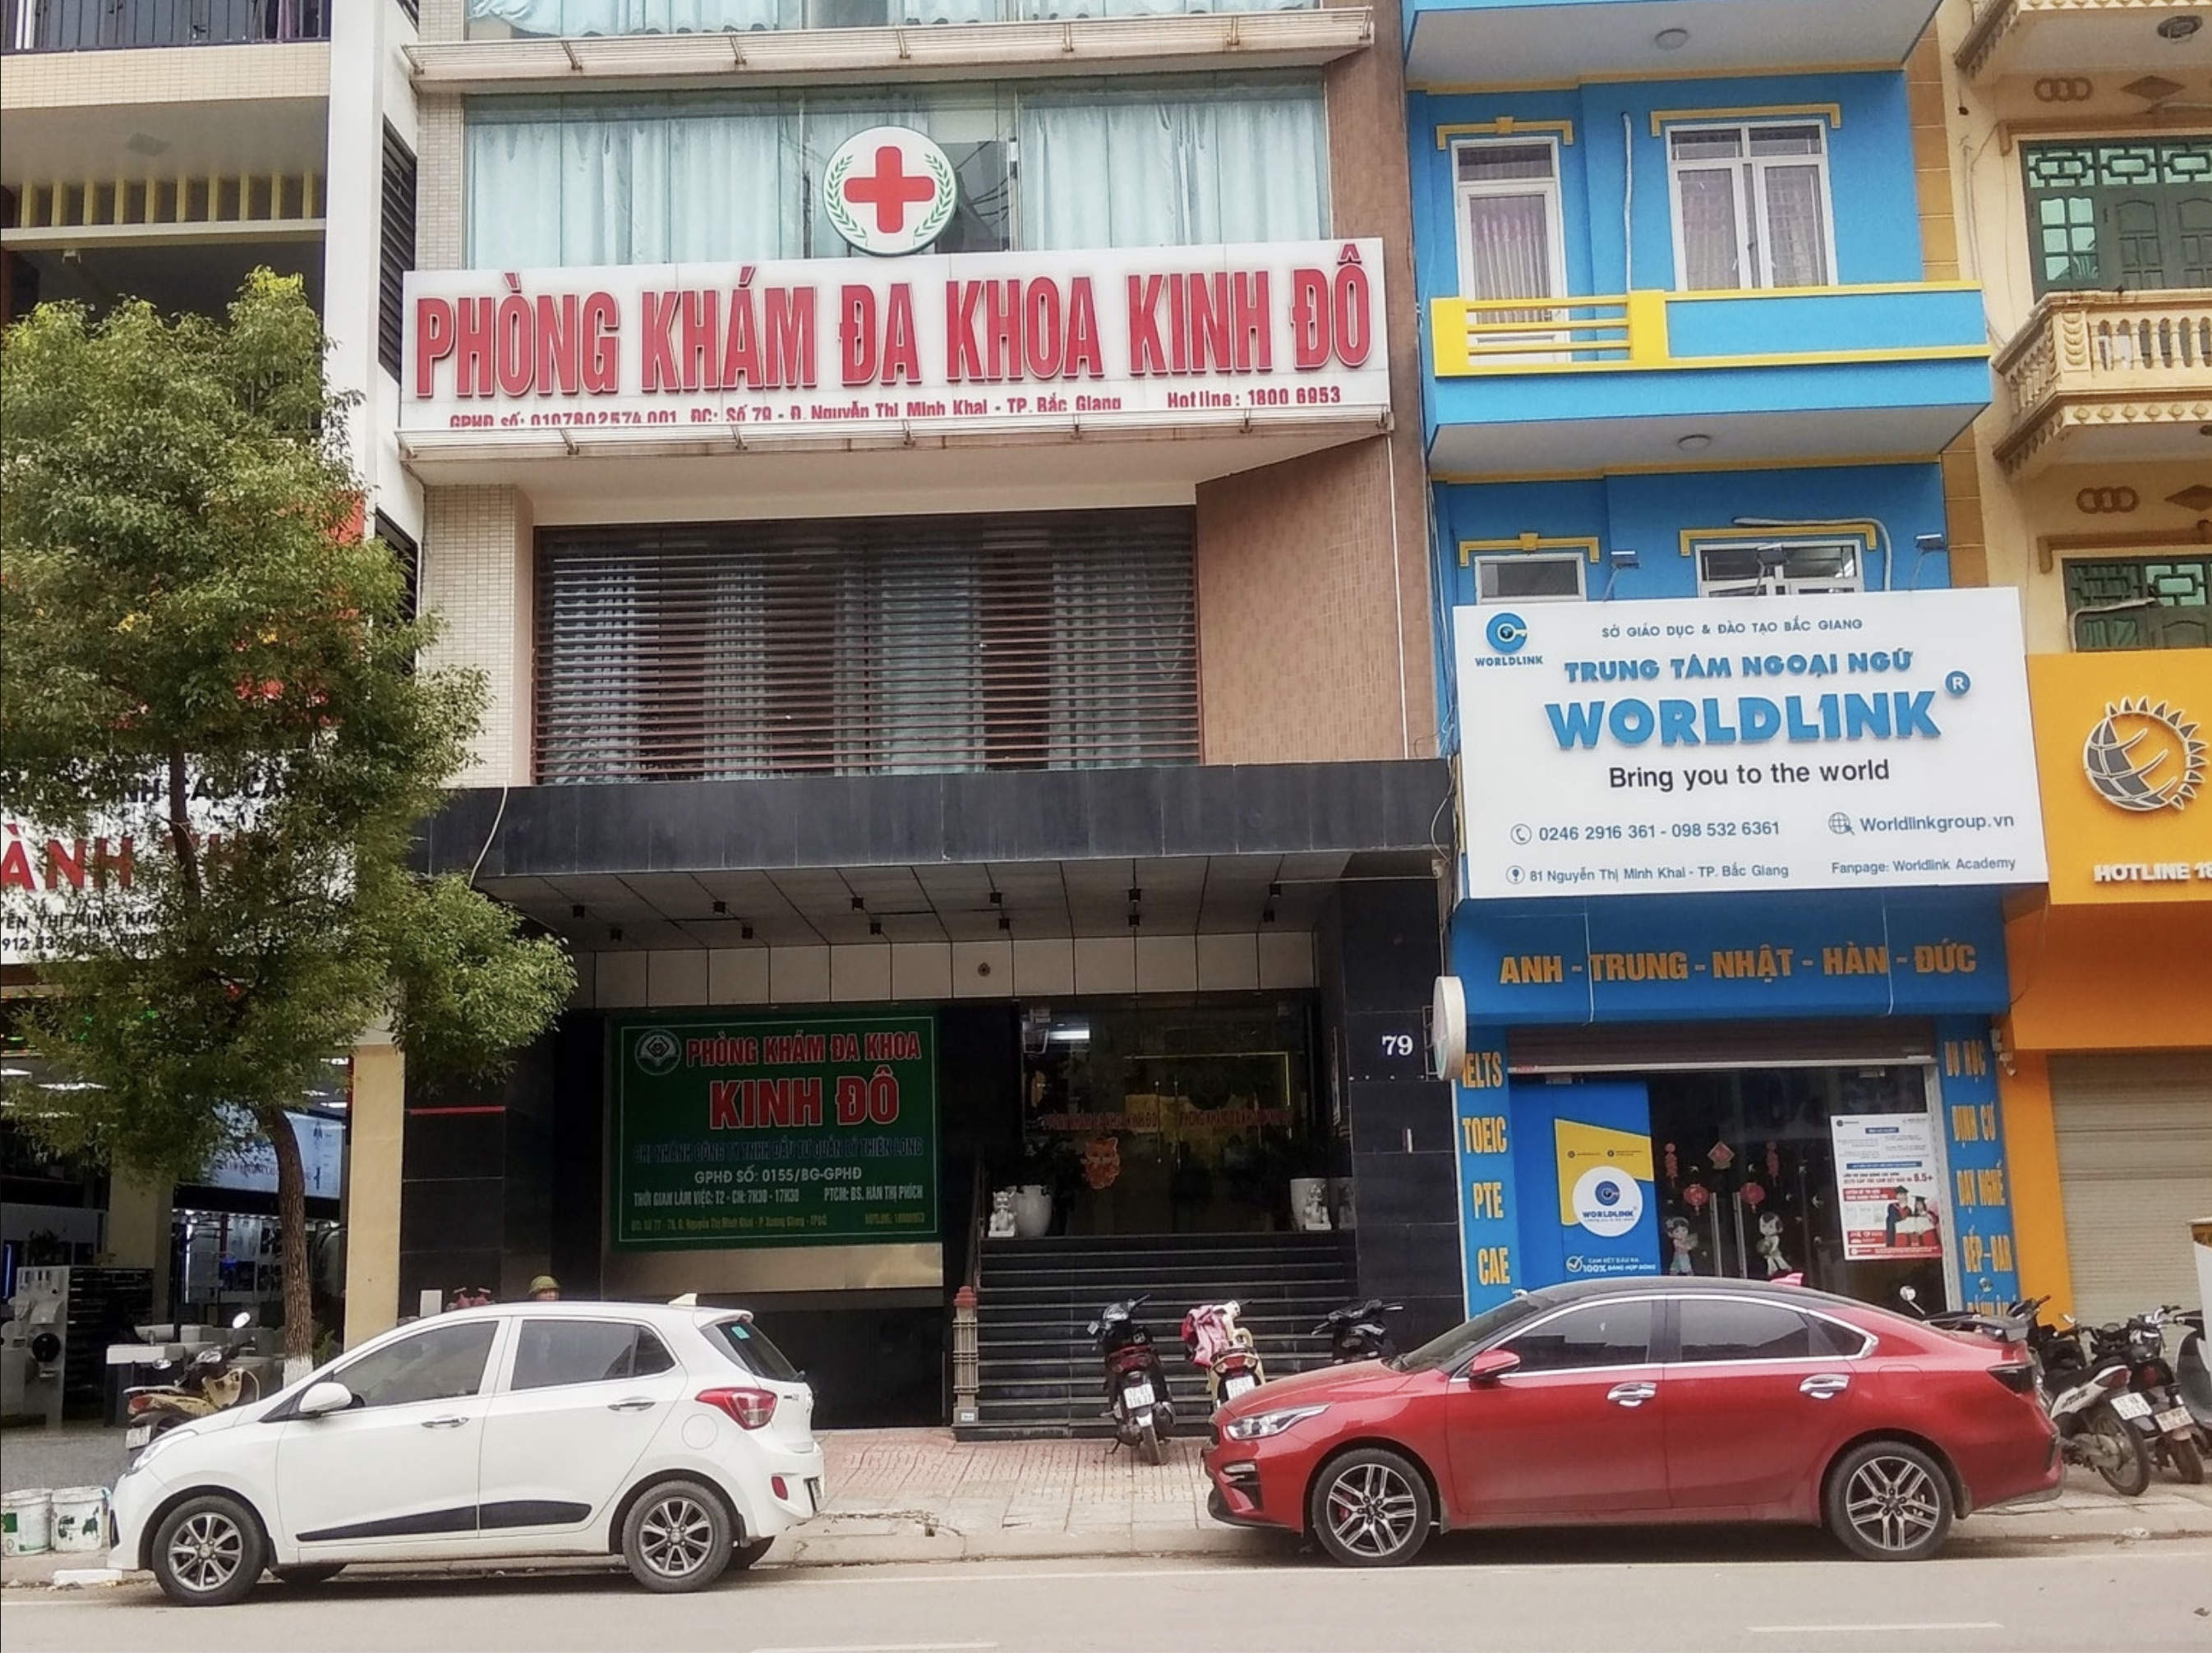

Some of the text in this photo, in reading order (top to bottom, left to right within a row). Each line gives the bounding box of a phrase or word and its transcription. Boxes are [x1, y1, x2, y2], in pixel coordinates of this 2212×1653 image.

[416, 243, 1371, 398] PHÒNG KHÁM ĐA KHOA KINH ĐÔ
[726, 403, 747, 422] Số
[752, 406, 772, 421] 79
[906, 399, 946, 417] Minh
[952, 398, 988, 416] Khai
[1007, 397, 1033, 413] TP.
[1036, 391, 1067, 412] Bắc
[1075, 394, 1122, 412] Giang
[1167, 390, 1240, 408] Hotline:
[1247, 388, 1289, 406] 1800
[1296, 385, 1341, 404] 6953
[1601, 615, 1863, 639] SỞ GIÁO DỤC & ĐÀO TẠO BẮC GIANG
[1475, 655, 1544, 667] WORLDLINK
[1564, 647, 1913, 684] TRUNG TÂM NGOẠI NGỮ
[1545, 691, 1942, 749] WORLDLINK
[1609, 759, 1890, 792] Bring you to the world
[1538, 826, 1578, 841] 0246
[1584, 826, 1622, 840] 2916
[1628, 824, 1656, 839] 361
[1671, 823, 1702, 837] 098
[1706, 822, 1736, 836] 532
[1741, 821, 1780, 836] 6361
[1859, 815, 2015, 833] Worldlinkgroup.vn
[1529, 870, 1543, 882] 81
[1546, 866, 1595, 884] Nguyễn
[1599, 868, 1619, 882] Thị
[1624, 867, 1653, 880] Minh
[1657, 866, 1685, 879] Khai
[1698, 865, 1718, 878] TP.
[1721, 862, 1746, 877] Bắc
[1751, 864, 1789, 879] Giang
[1832, 857, 2016, 876] Fanpage: Worldlink Academy
[2094, 862, 2191, 882] HOTLINE
[1500, 955, 1563, 984] ANH
[1589, 951, 1689, 982] TRUNG
[1712, 944, 1794, 983] NHẬT
[1822, 941, 1887, 975] HÀN
[1914, 937, 1976, 974] ĐỨC
[686, 1029, 922, 1067] PHÒNG KHÁM ĐA KHOA
[1381, 1034, 1413, 1057] 79
[710, 1064, 900, 1130] KINH ĐÔ
[1462, 1116, 1507, 1153] TOEIC
[694, 1164, 862, 1184] GPHĐ SỐ: 0155/BG-GPHĐ
[850, 1186, 864, 1200] BS.
[1472, 1182, 1504, 1219] PTE
[1477, 1247, 1510, 1286] CAE
[1583, 1264, 1606, 1273] 100%
